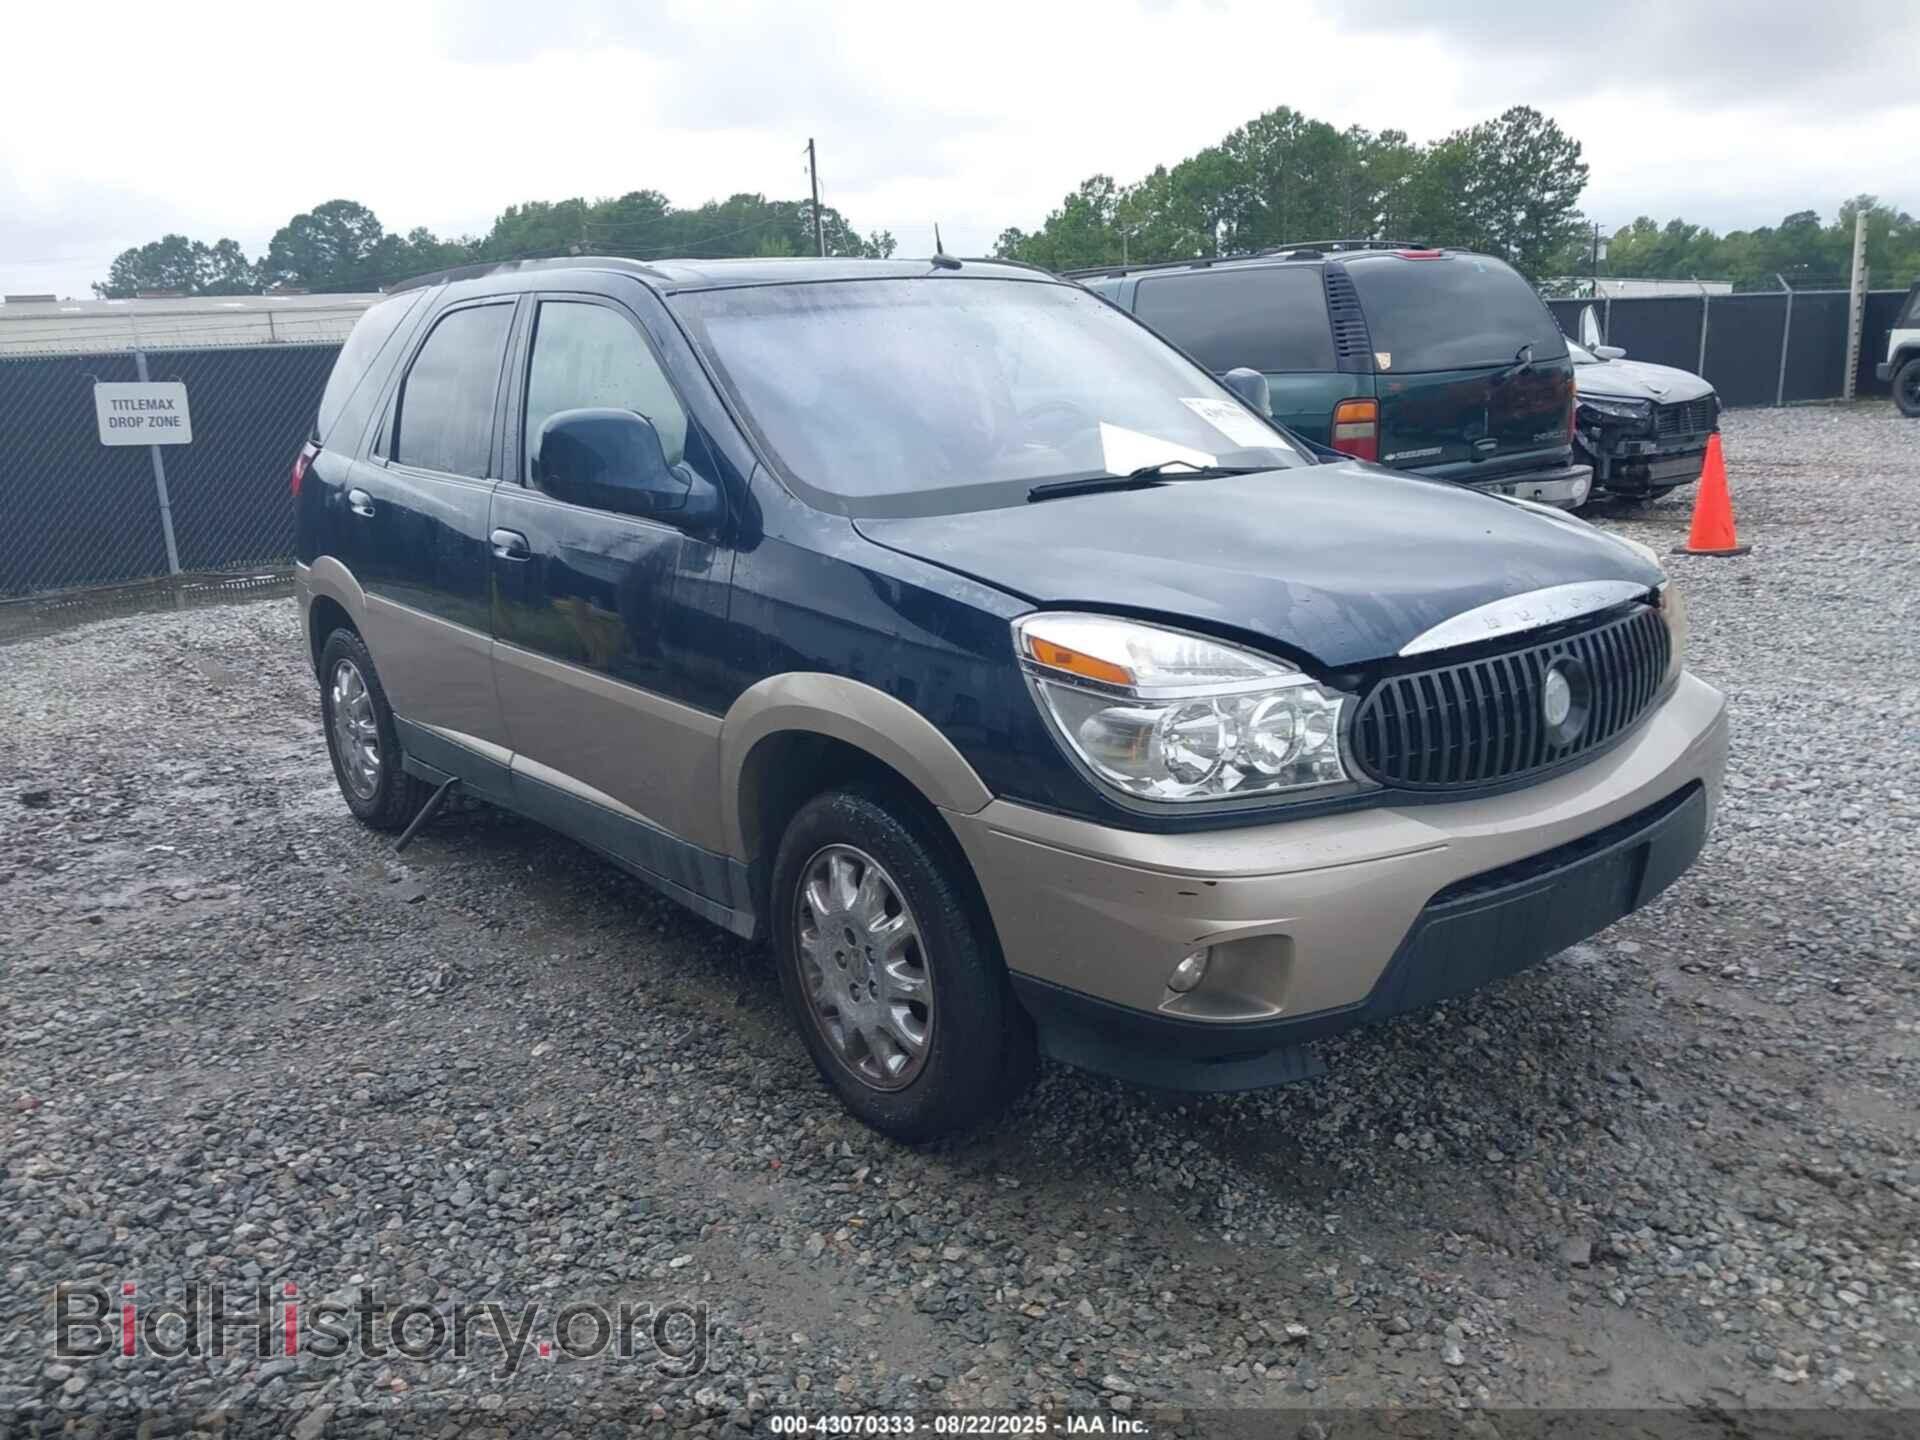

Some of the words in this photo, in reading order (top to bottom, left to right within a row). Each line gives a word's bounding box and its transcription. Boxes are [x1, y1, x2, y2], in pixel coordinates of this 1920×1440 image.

[110, 399, 175, 411] TITLEMAX
[108, 416, 144, 429] DROP
[147, 415, 182, 428] ZONE
